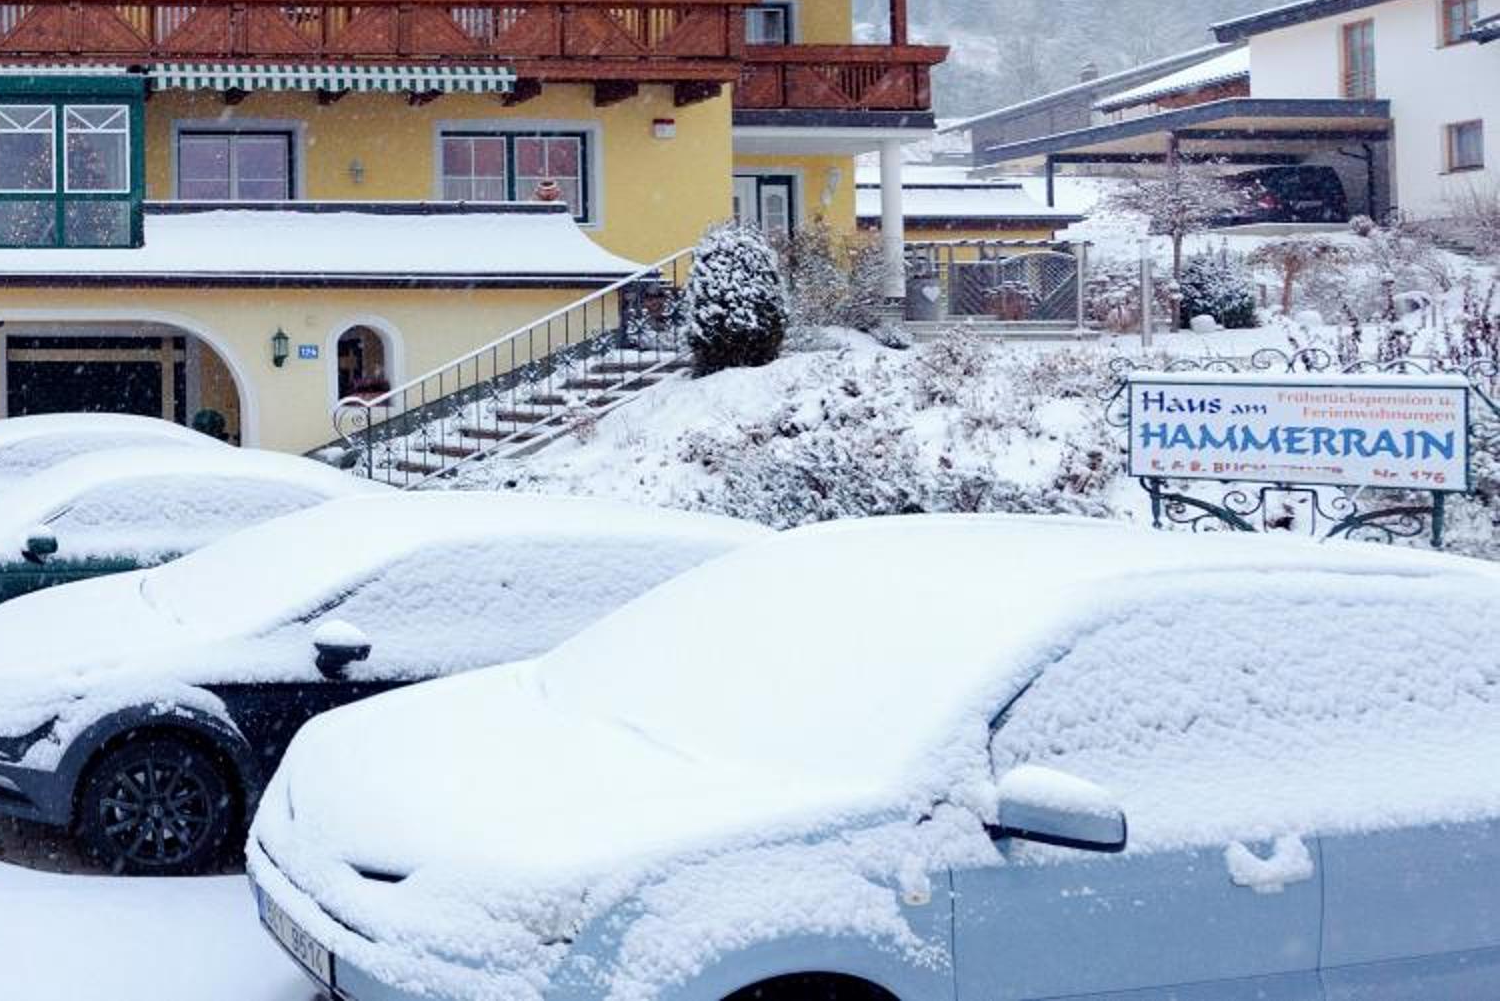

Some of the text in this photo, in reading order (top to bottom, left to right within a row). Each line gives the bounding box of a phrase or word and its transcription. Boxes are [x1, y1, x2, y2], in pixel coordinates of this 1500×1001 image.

[1141, 390, 1268, 415] Haus am
[1303, 406, 1456, 423] Ferienwohnungen
[1140, 422, 1456, 460] HAMMERRAIN
